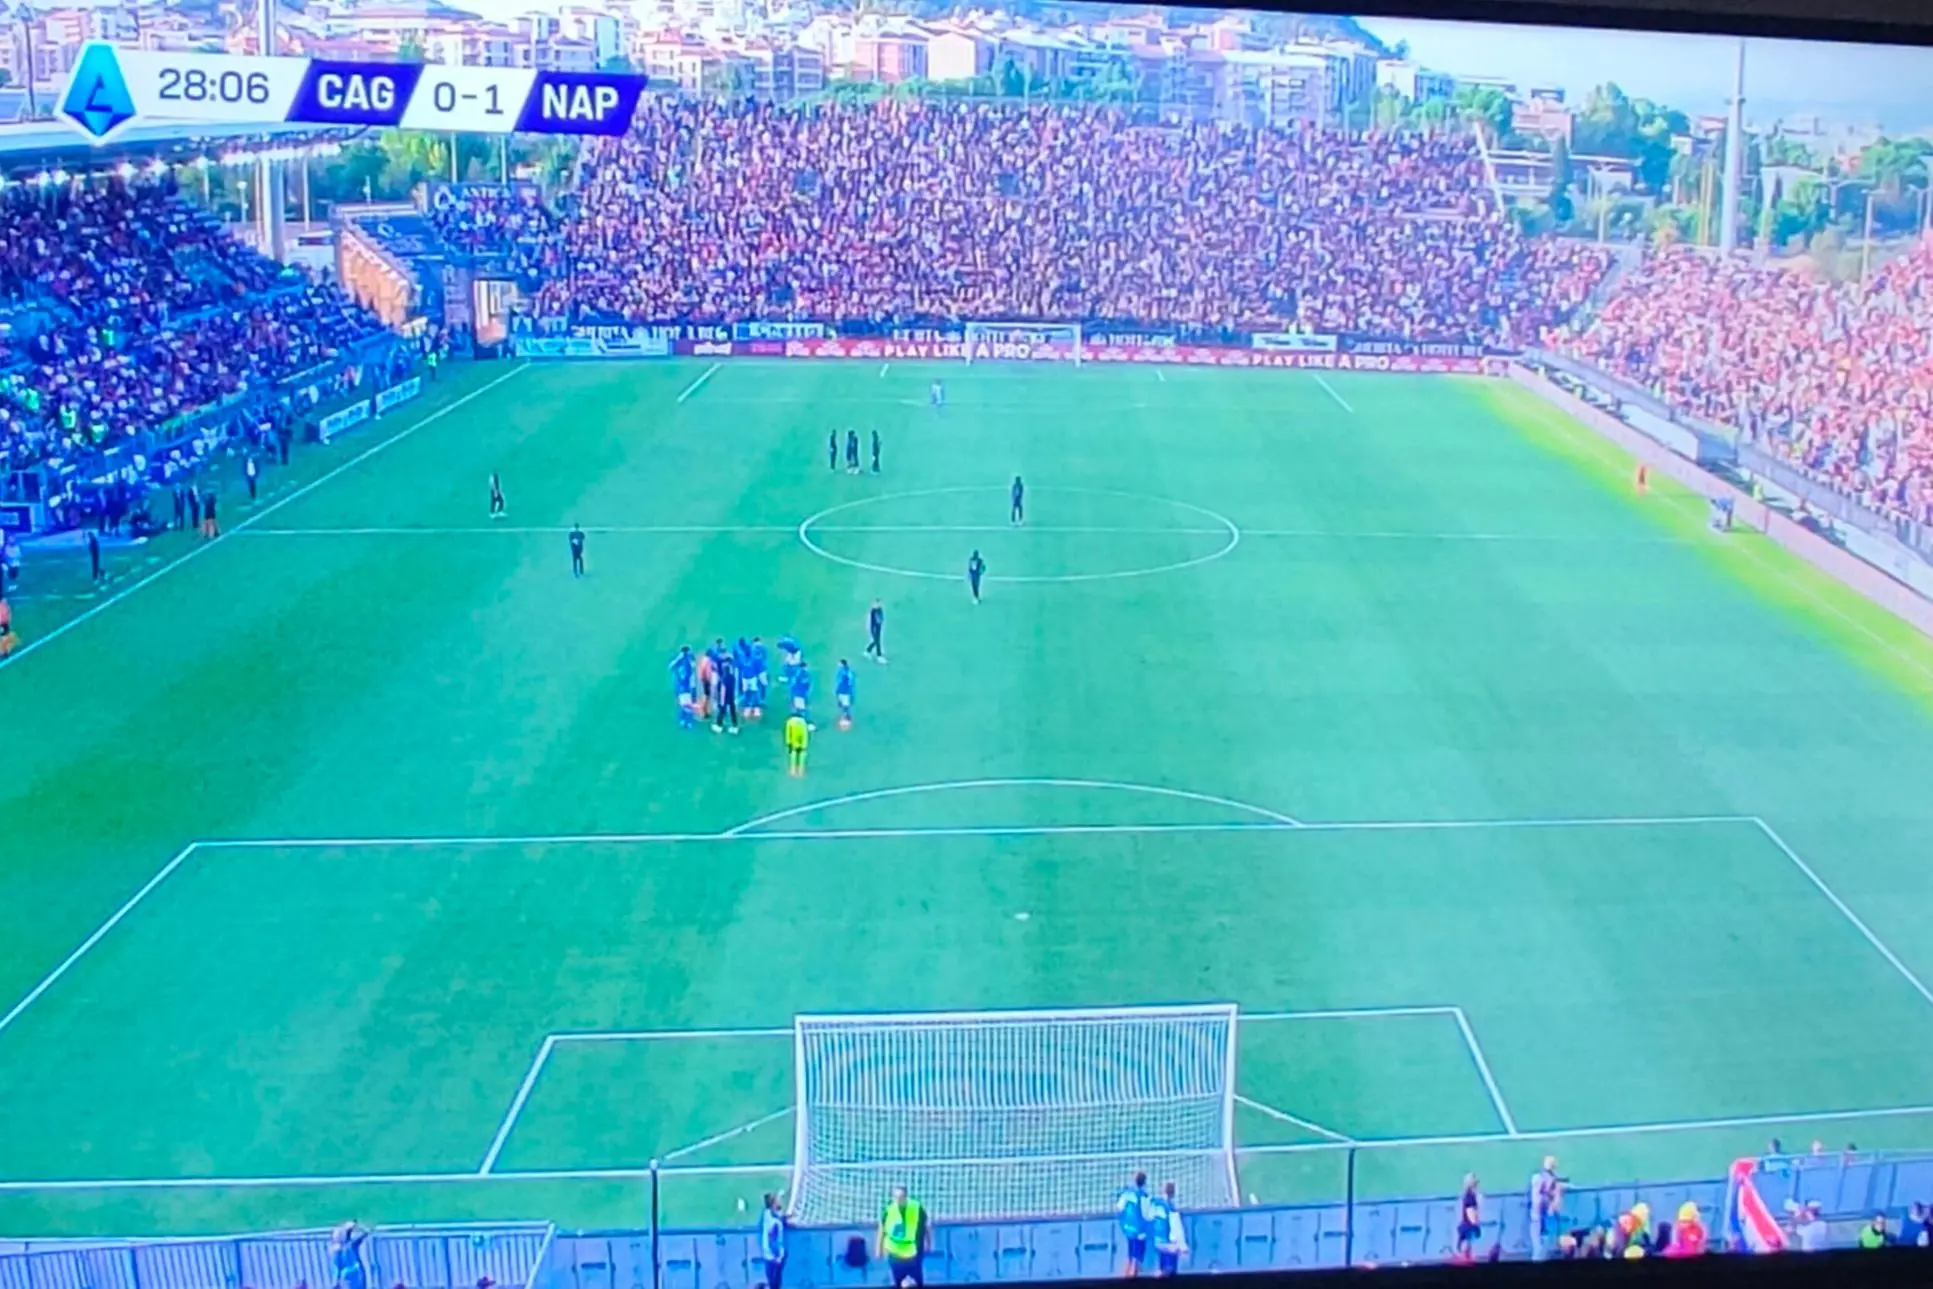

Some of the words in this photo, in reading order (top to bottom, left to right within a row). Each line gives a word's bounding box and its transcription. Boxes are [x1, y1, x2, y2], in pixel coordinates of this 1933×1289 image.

[158, 68, 270, 104] 28:06
[317, 73, 396, 112] CAG
[433, 82, 504, 115] 0-1
[541, 82, 620, 121] NAP
[884, 342, 928, 357] PLAY
[975, 343, 990, 358] A
[993, 343, 1031, 359] PRO
[1252, 352, 1293, 367] PLAY
[1354, 355, 1390, 371] PRO
